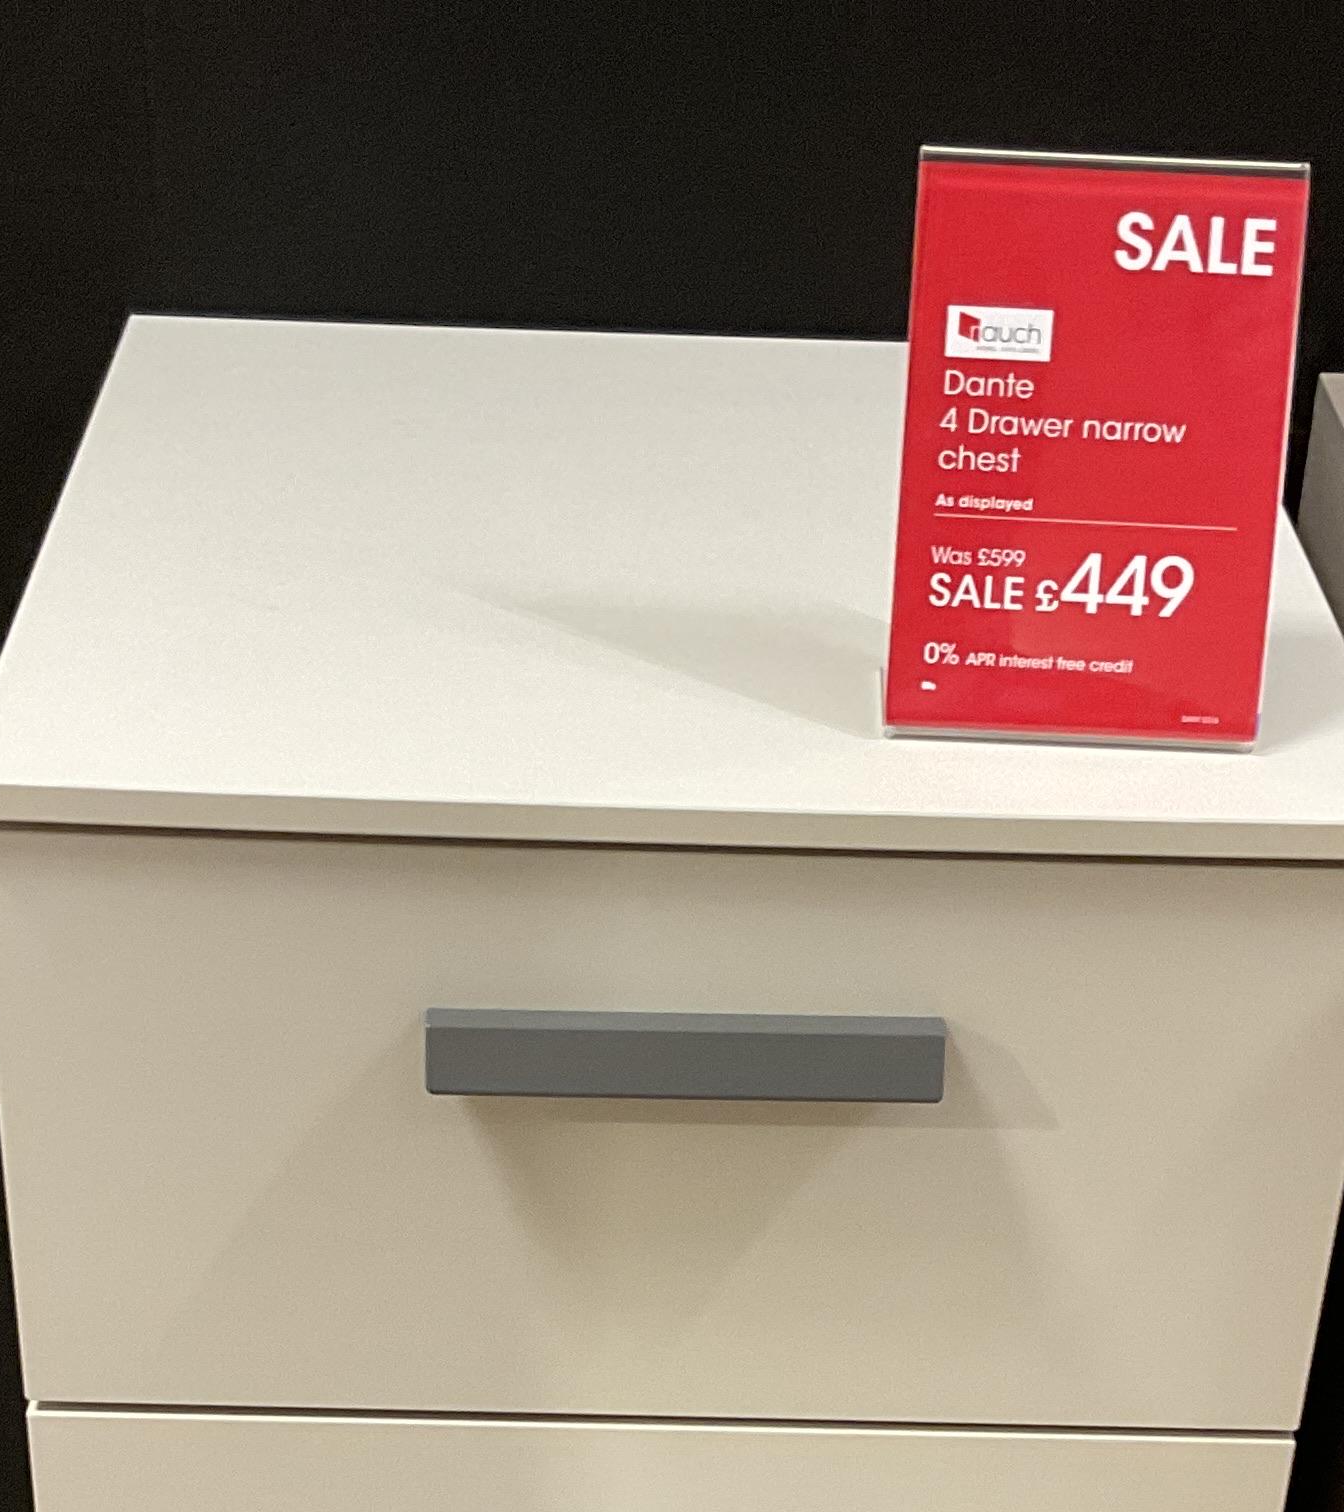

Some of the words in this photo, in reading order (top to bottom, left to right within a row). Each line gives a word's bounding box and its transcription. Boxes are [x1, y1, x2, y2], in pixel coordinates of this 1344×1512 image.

[1114, 211, 1278, 277] SALE
[943, 369, 1036, 399] Dante
[939, 408, 958, 433] 4
[967, 408, 1074, 438] Drawer
[1082, 418, 1187, 444] narrow
[937, 443, 1022, 473] chest
[934, 493, 955, 508] As
[958, 495, 1034, 513] displayed
[930, 546, 973, 566] Was
[977, 547, 1027, 568] £599
[928, 572, 1025, 611] SALE
[1034, 552, 1195, 618] £449
[923, 641, 960, 665] 0%
[964, 652, 997, 668] APR
[998, 654, 1055, 671] interest
[1055, 657, 1087, 673] free
[1088, 659, 1134, 674] credit
